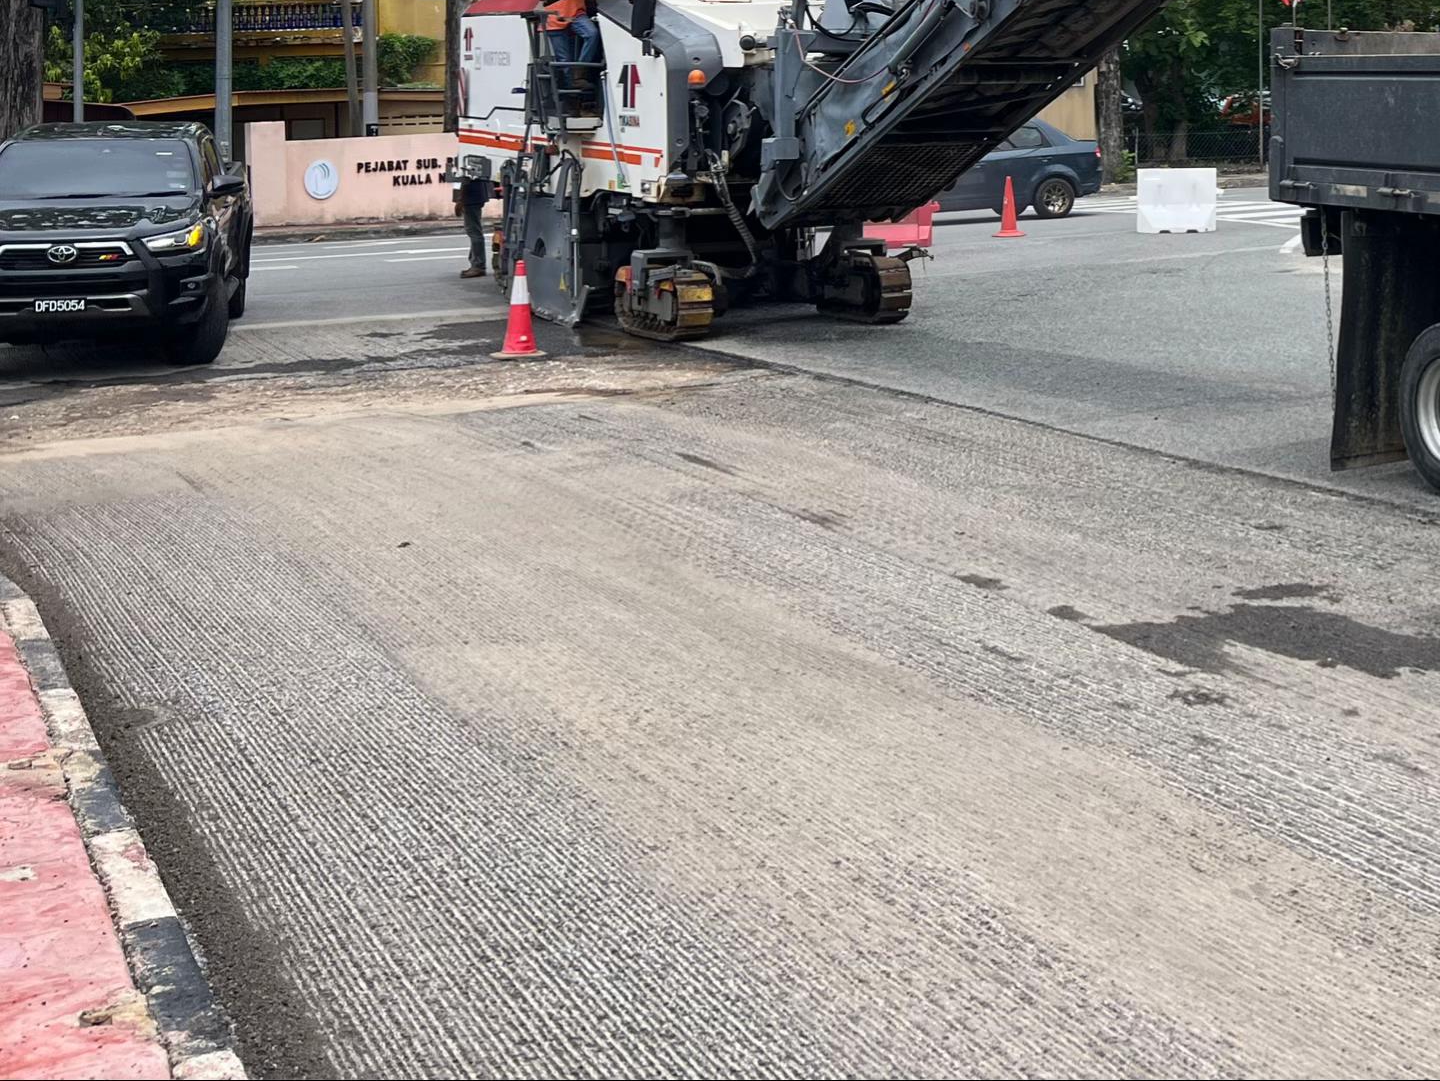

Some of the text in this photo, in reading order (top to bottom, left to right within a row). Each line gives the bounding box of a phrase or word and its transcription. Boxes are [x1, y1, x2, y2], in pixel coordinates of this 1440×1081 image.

[357, 160, 409, 173] PEJABAT
[416, 158, 442, 170] SUB.
[392, 173, 432, 186] KUALA
[35, 300, 85, 312] DFD5054
